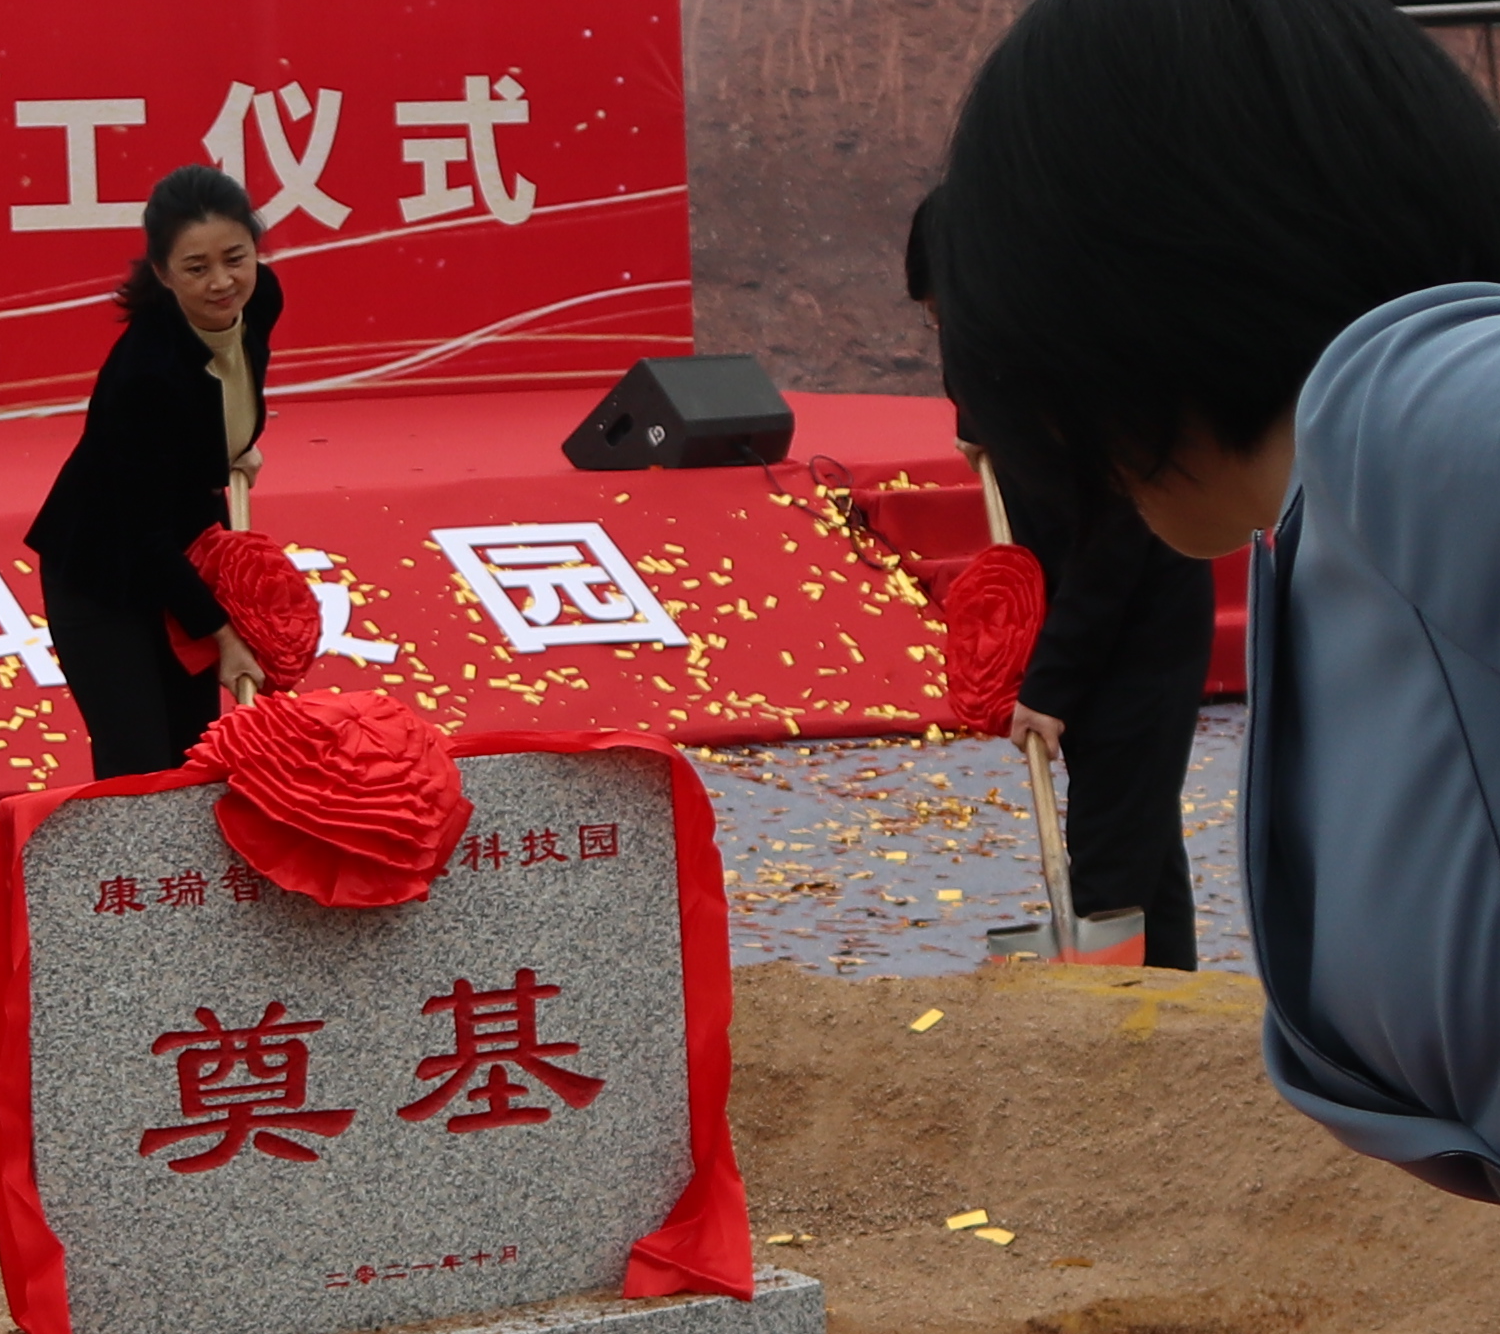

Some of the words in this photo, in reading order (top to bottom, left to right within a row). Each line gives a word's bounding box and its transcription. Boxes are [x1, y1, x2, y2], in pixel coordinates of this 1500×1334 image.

[93, 821, 619, 915] 康瑞智科技园
[138, 967, 605, 1174] 奠基
[325, 1245, 518, 1289] 二零二一年十月
